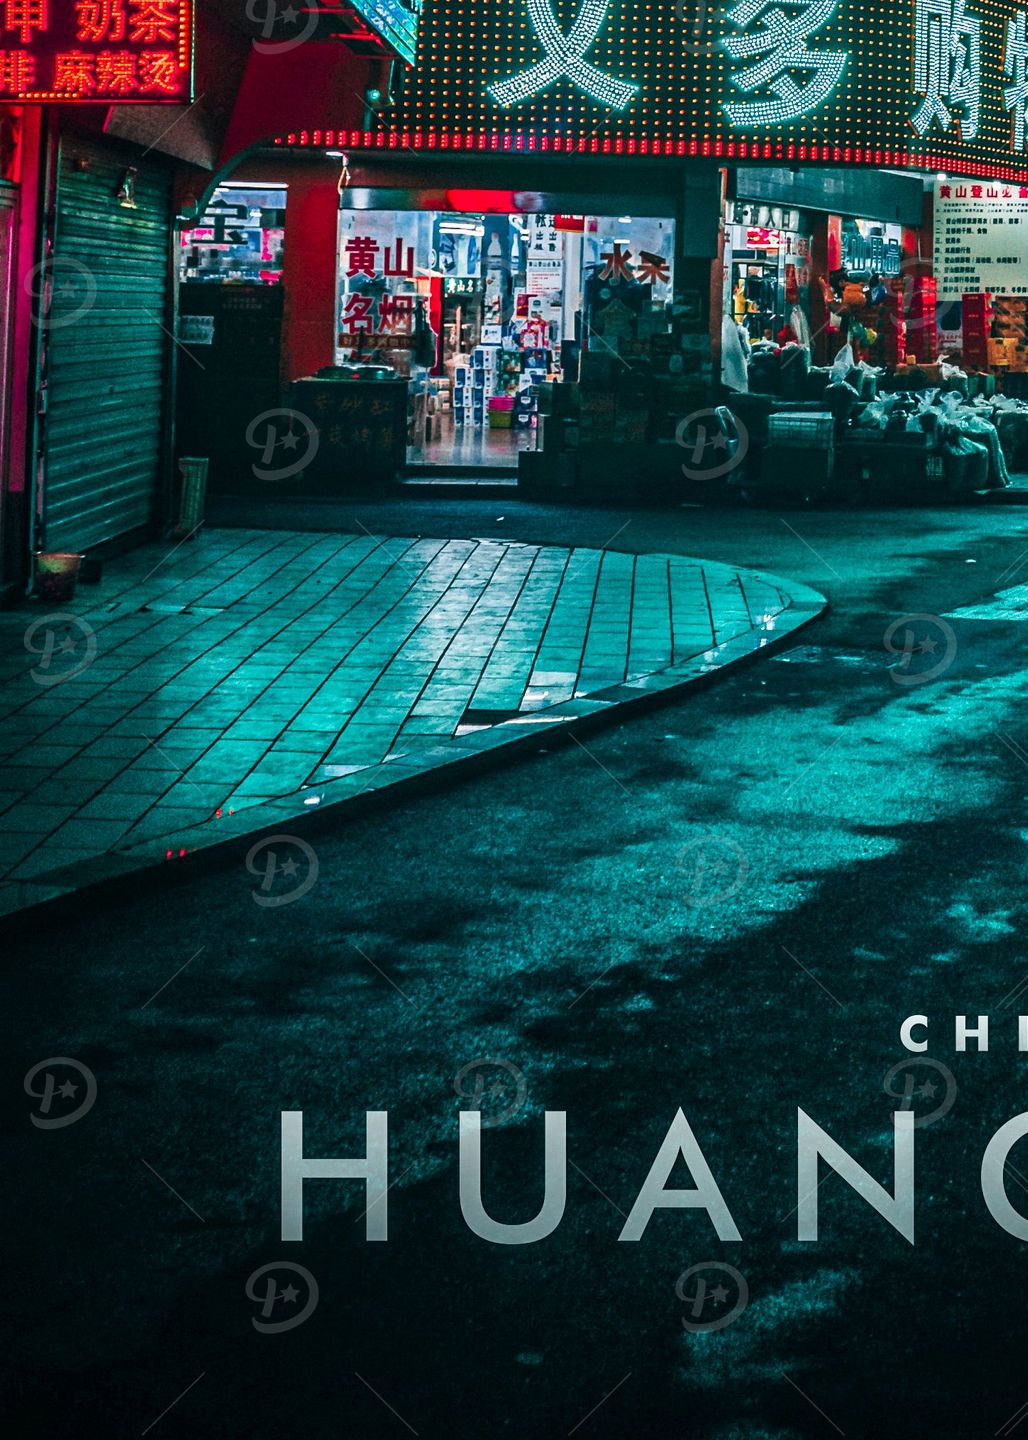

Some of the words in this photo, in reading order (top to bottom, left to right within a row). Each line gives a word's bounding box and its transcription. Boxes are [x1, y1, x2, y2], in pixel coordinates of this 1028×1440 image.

[53, 49, 180, 95] 麻辣烫
[345, 236, 415, 278] 黄山
[341, 293, 414, 336] 名烟
